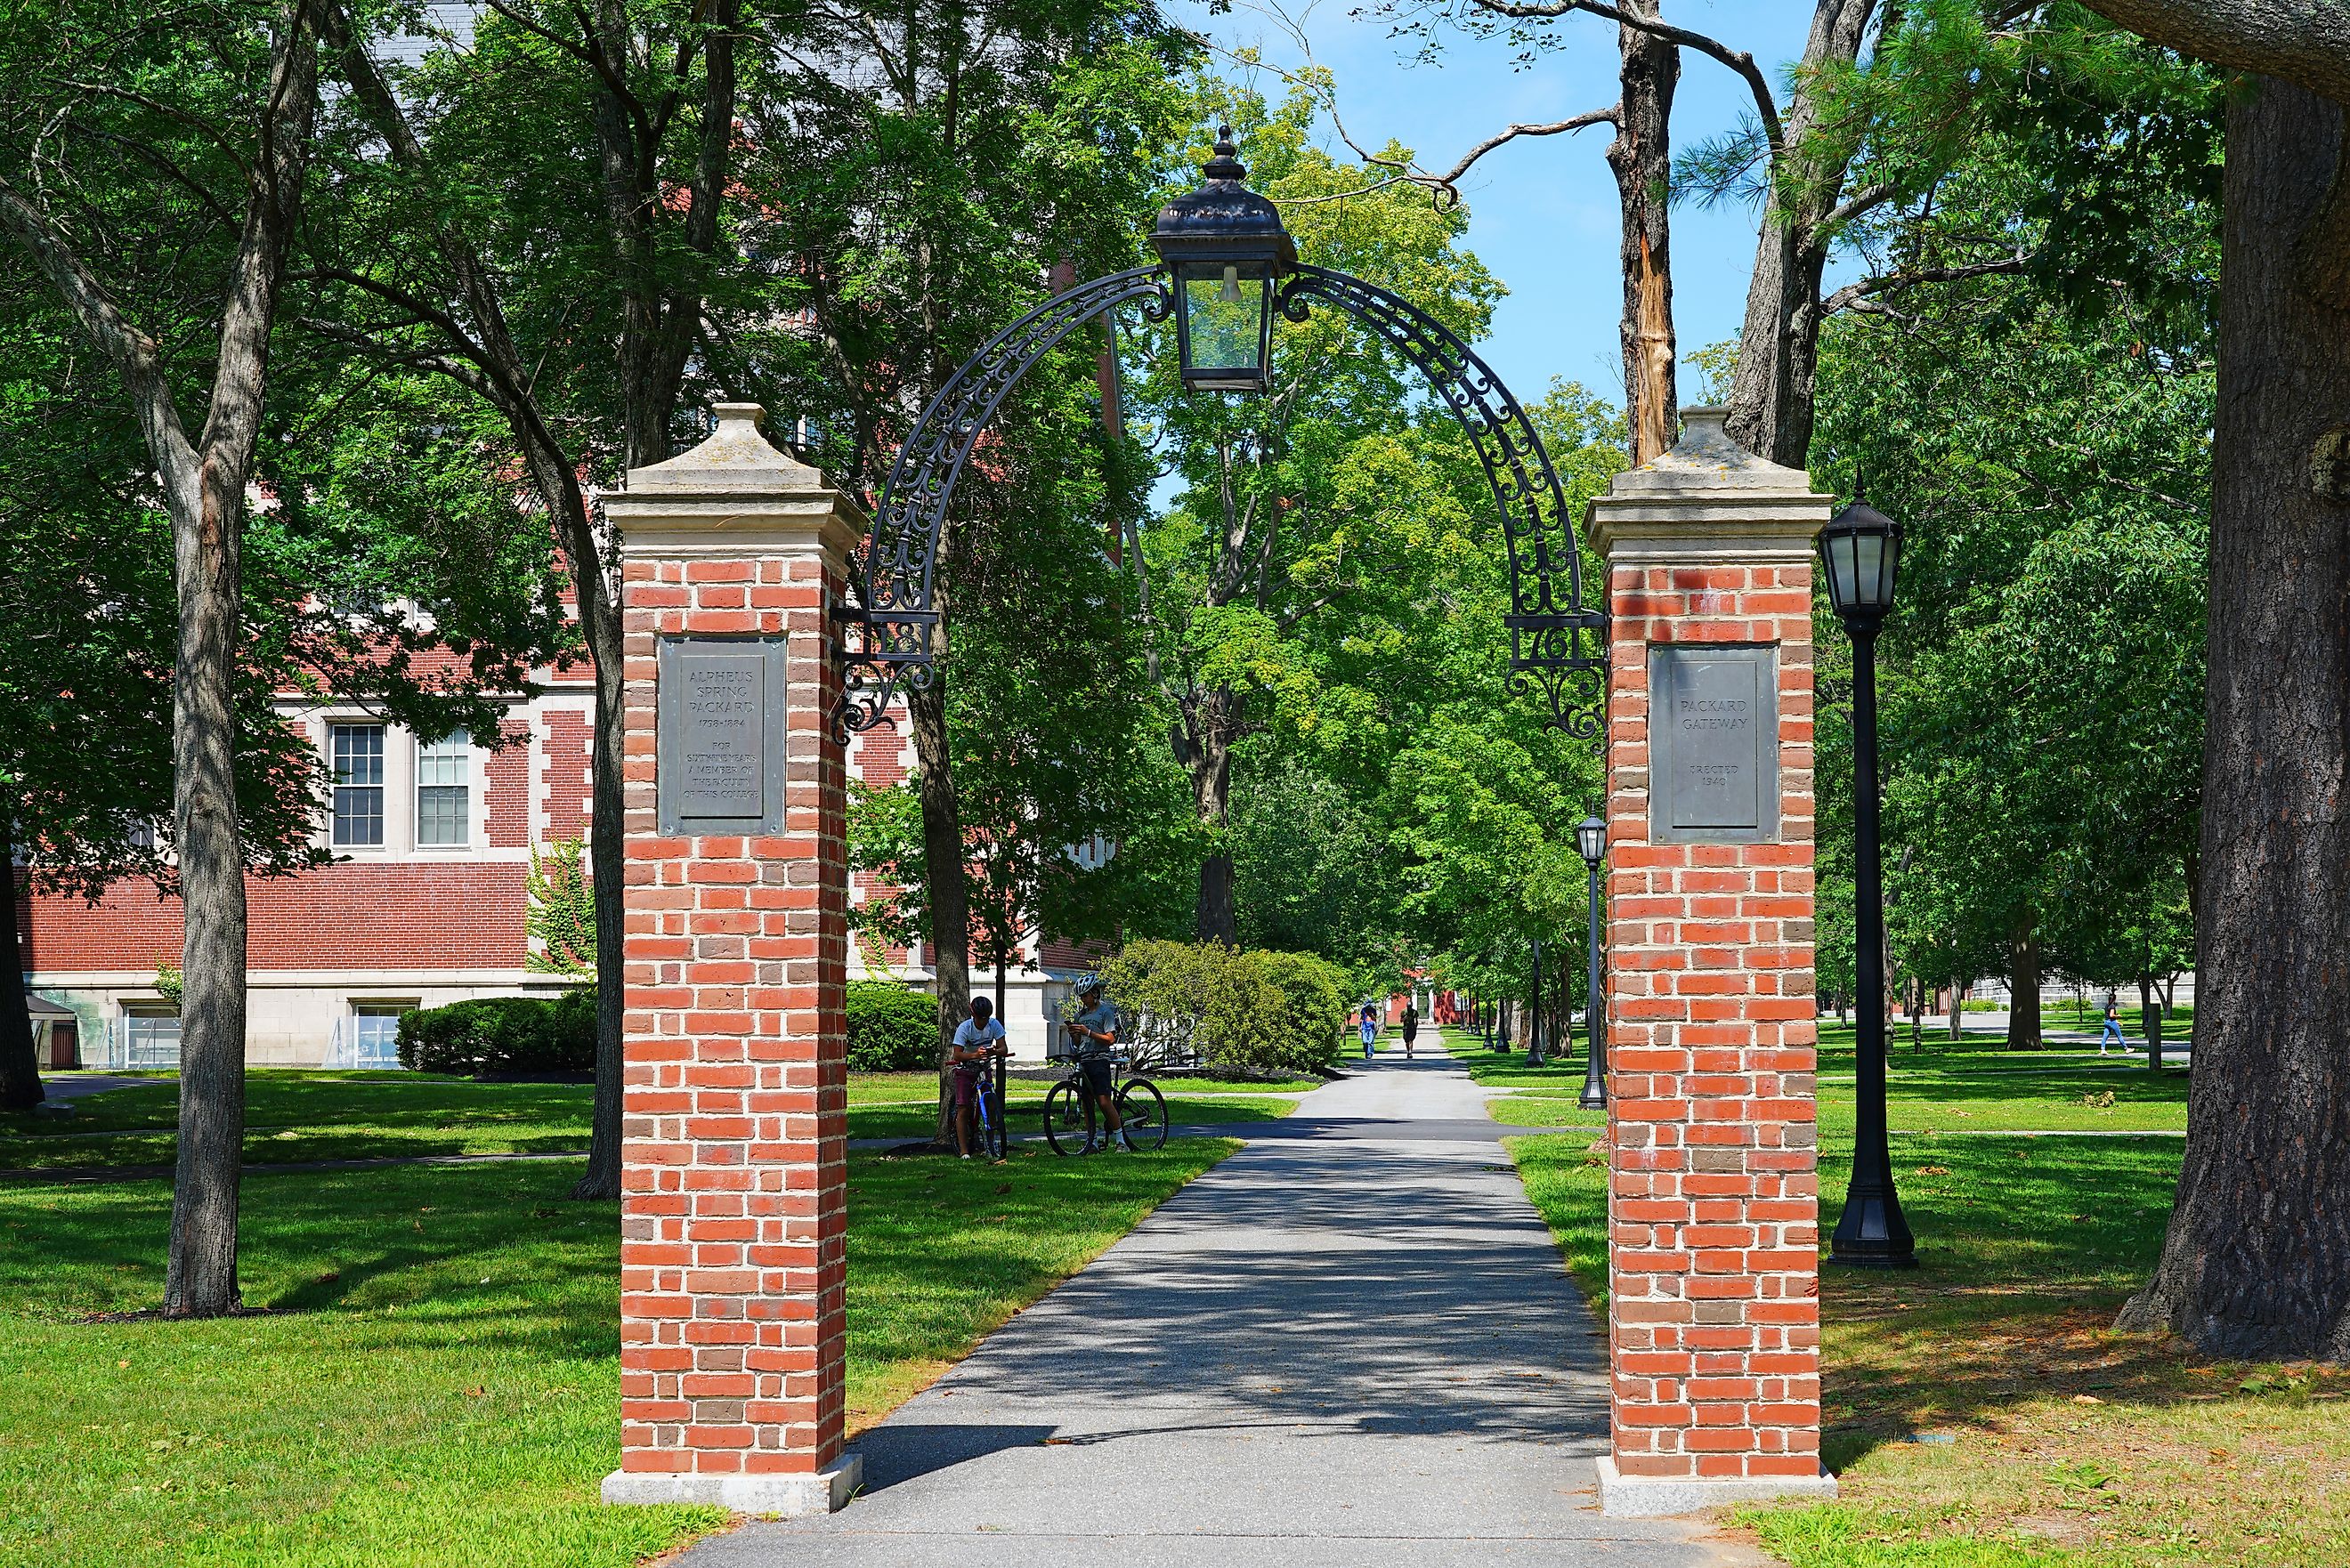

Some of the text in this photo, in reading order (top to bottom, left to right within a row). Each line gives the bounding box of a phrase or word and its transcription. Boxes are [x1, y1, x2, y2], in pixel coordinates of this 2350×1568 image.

[689, 671, 753, 683] ALPHEUS
[697, 686, 747, 698] SPRING
[689, 701, 755, 713] PACKARD
[1681, 700, 1746, 712] PACKARD
[699, 719, 745, 728] 1798-1884
[1682, 718, 1748, 730] GATEWAY
[712, 742, 731, 750] FOR
[728, 754, 757, 763] YEARS
[688, 765, 754, 774] A MEMBER OF
[1690, 765, 1738, 774] ERECTED
[693, 778, 750, 787] THE FACULTY
[1702, 777, 1727, 786] 1940
[683, 790, 758, 798] OF THIS COLLEGE
